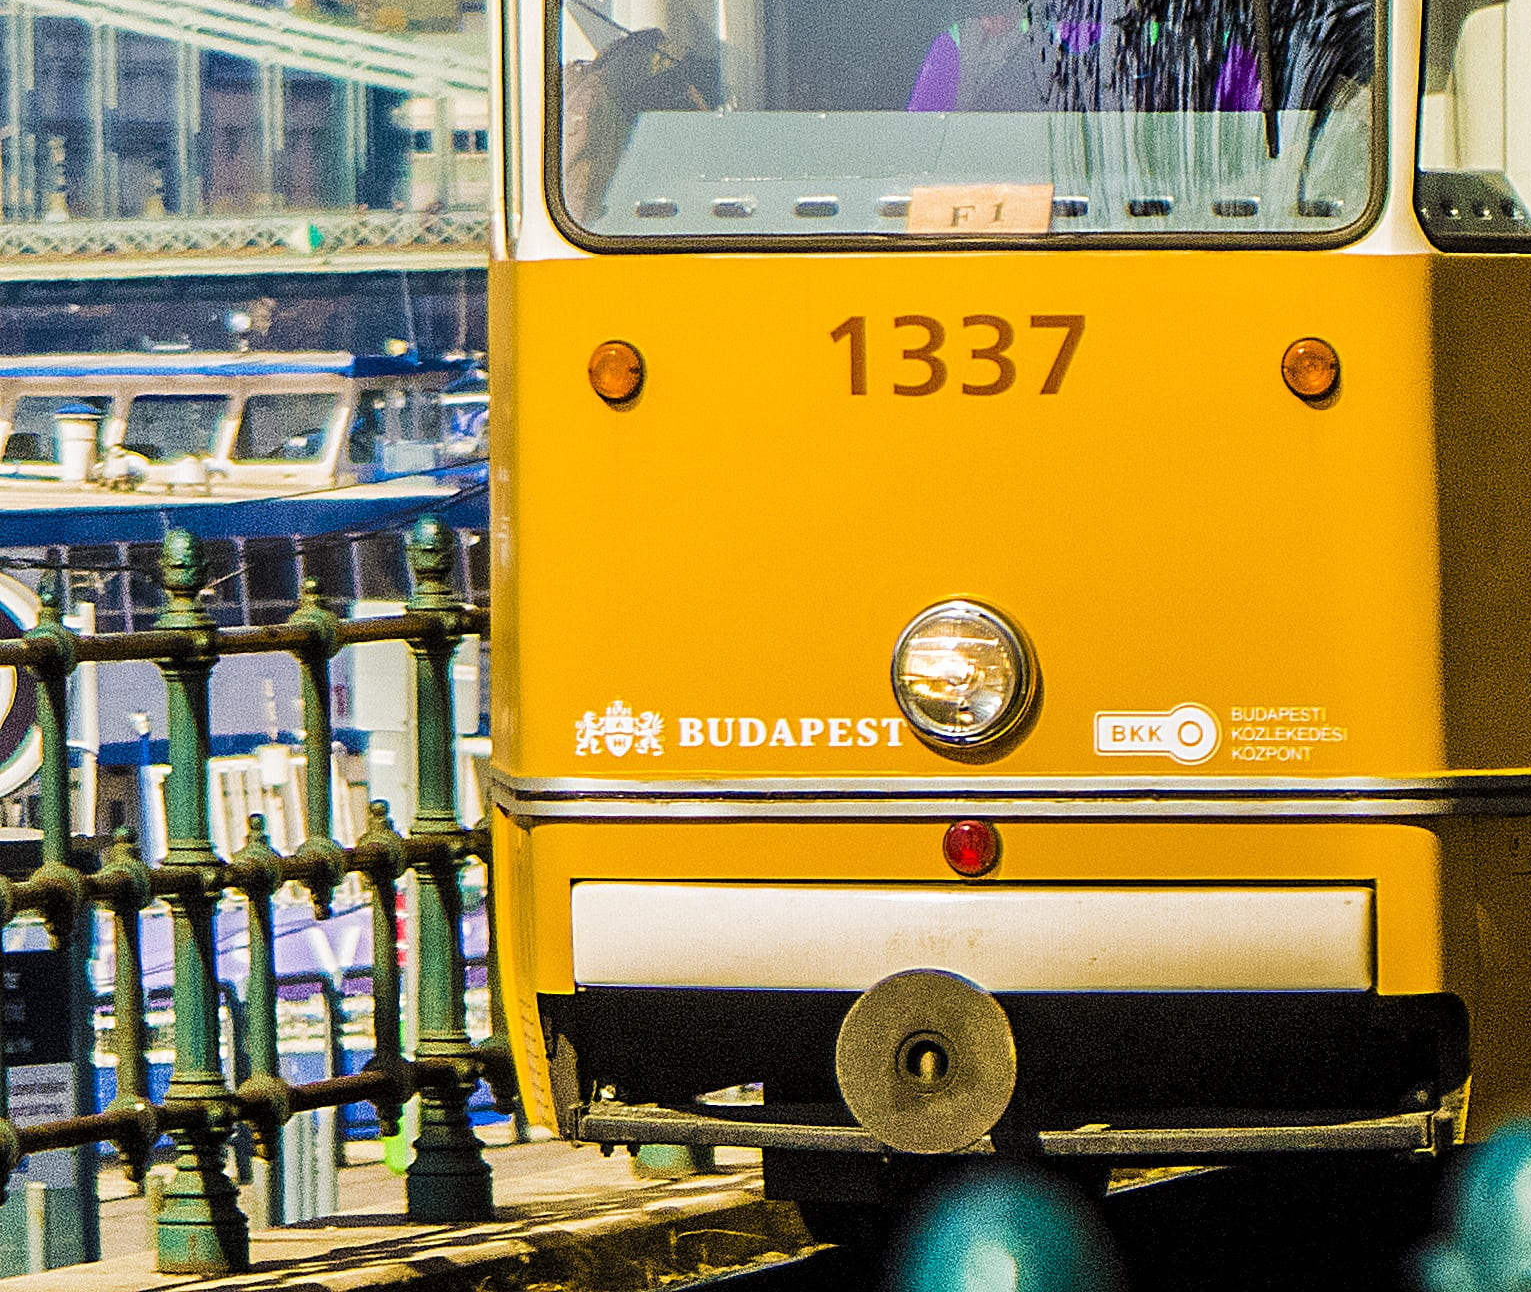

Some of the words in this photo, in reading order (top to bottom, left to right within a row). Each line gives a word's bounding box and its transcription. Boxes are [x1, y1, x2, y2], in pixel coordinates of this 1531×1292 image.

[830, 314, 1086, 397] 1337
[1231, 707, 1327, 722] BUDAPESTI
[678, 717, 906, 748] BUDAPEST
[1111, 724, 1163, 743] BKK
[1231, 724, 1348, 741] KÖZLEKEDÉSI
[1231, 743, 1313, 761] KÖZPONT
